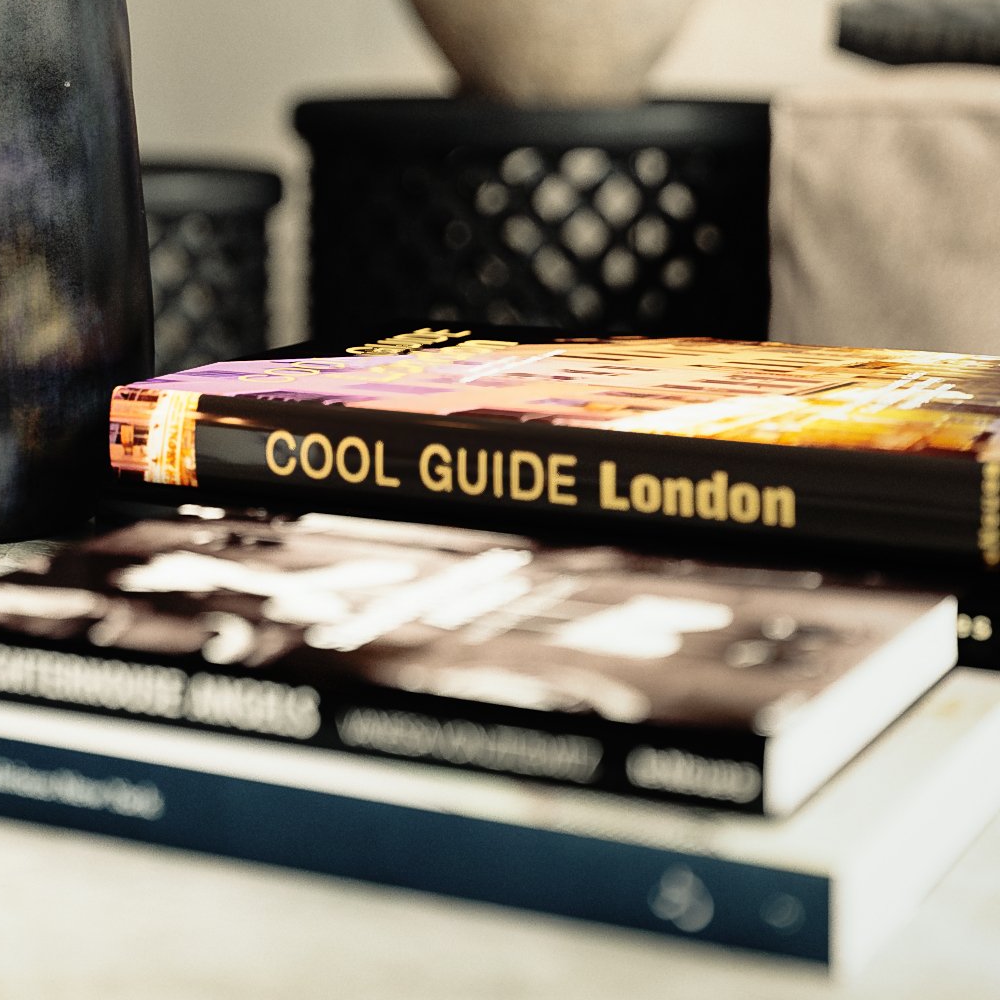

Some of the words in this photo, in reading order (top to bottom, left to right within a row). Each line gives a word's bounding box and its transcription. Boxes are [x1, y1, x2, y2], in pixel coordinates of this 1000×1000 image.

[265, 429, 401, 488] COOL
[418, 443, 578, 506] GUIDE
[599, 460, 796, 528] London
